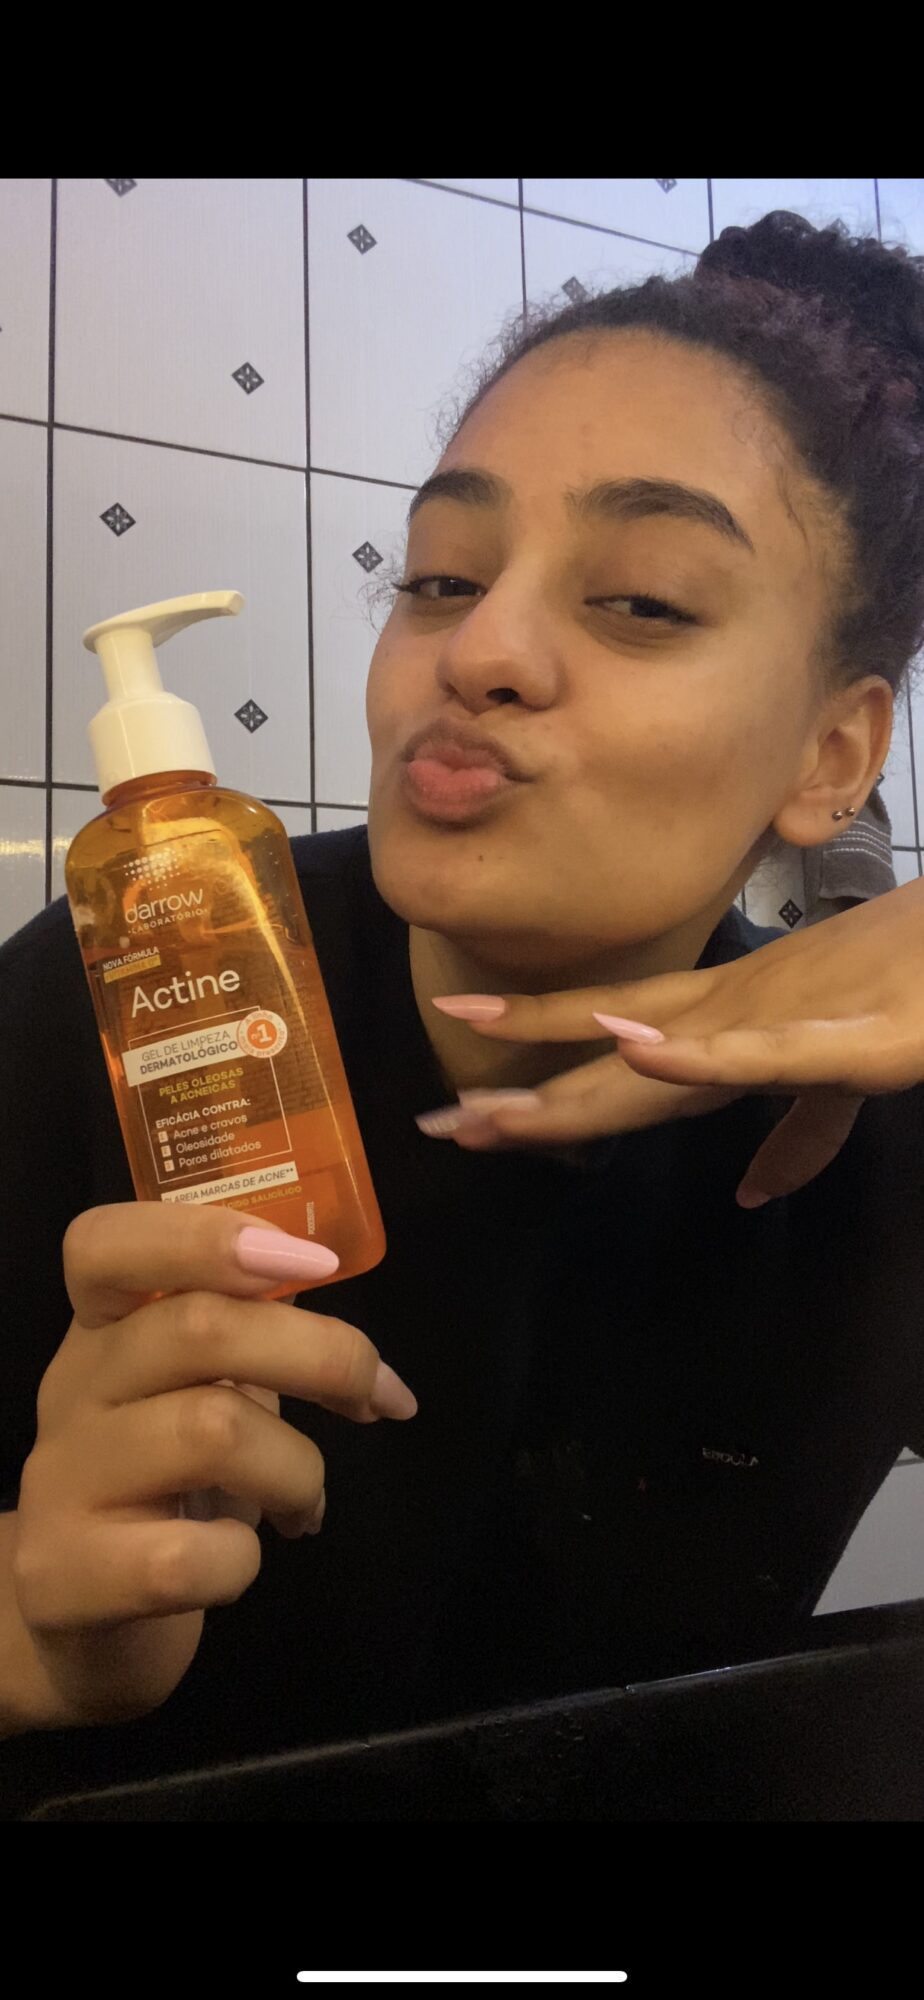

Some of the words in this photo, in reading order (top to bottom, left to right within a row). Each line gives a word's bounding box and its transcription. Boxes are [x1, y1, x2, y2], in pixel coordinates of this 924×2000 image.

[125, 888, 203, 924] darrow
[103, 958, 124, 971] NOVA
[131, 969, 240, 1018] Actine
[140, 1040, 238, 1075] DERMATOLÓGICO
[141, 1049, 162, 1062] GEL
[163, 1043, 179, 1056] DE
[180, 1030, 231, 1050] LIMPEZA
[159, 1081, 189, 1097] PELES
[191, 1067, 244, 1087] OLEOSAS
[170, 1095, 178, 1104] A
[180, 1080, 236, 1102] ACNEICAS
[155, 1109, 200, 1129] EFICÁCIA
[202, 1098, 251, 1116] CONTRA:
[173, 1127, 199, 1140] Acne
[201, 1124, 208, 1133] e
[210, 1114, 248, 1131] cravos
[176, 1131, 235, 1154] Oleosidade
[179, 1153, 208, 1168] Poros
[210, 1141, 262, 1161] dilatados
[200, 1180, 240, 1197] MARCAS
[242, 1176, 256, 1188] DE
